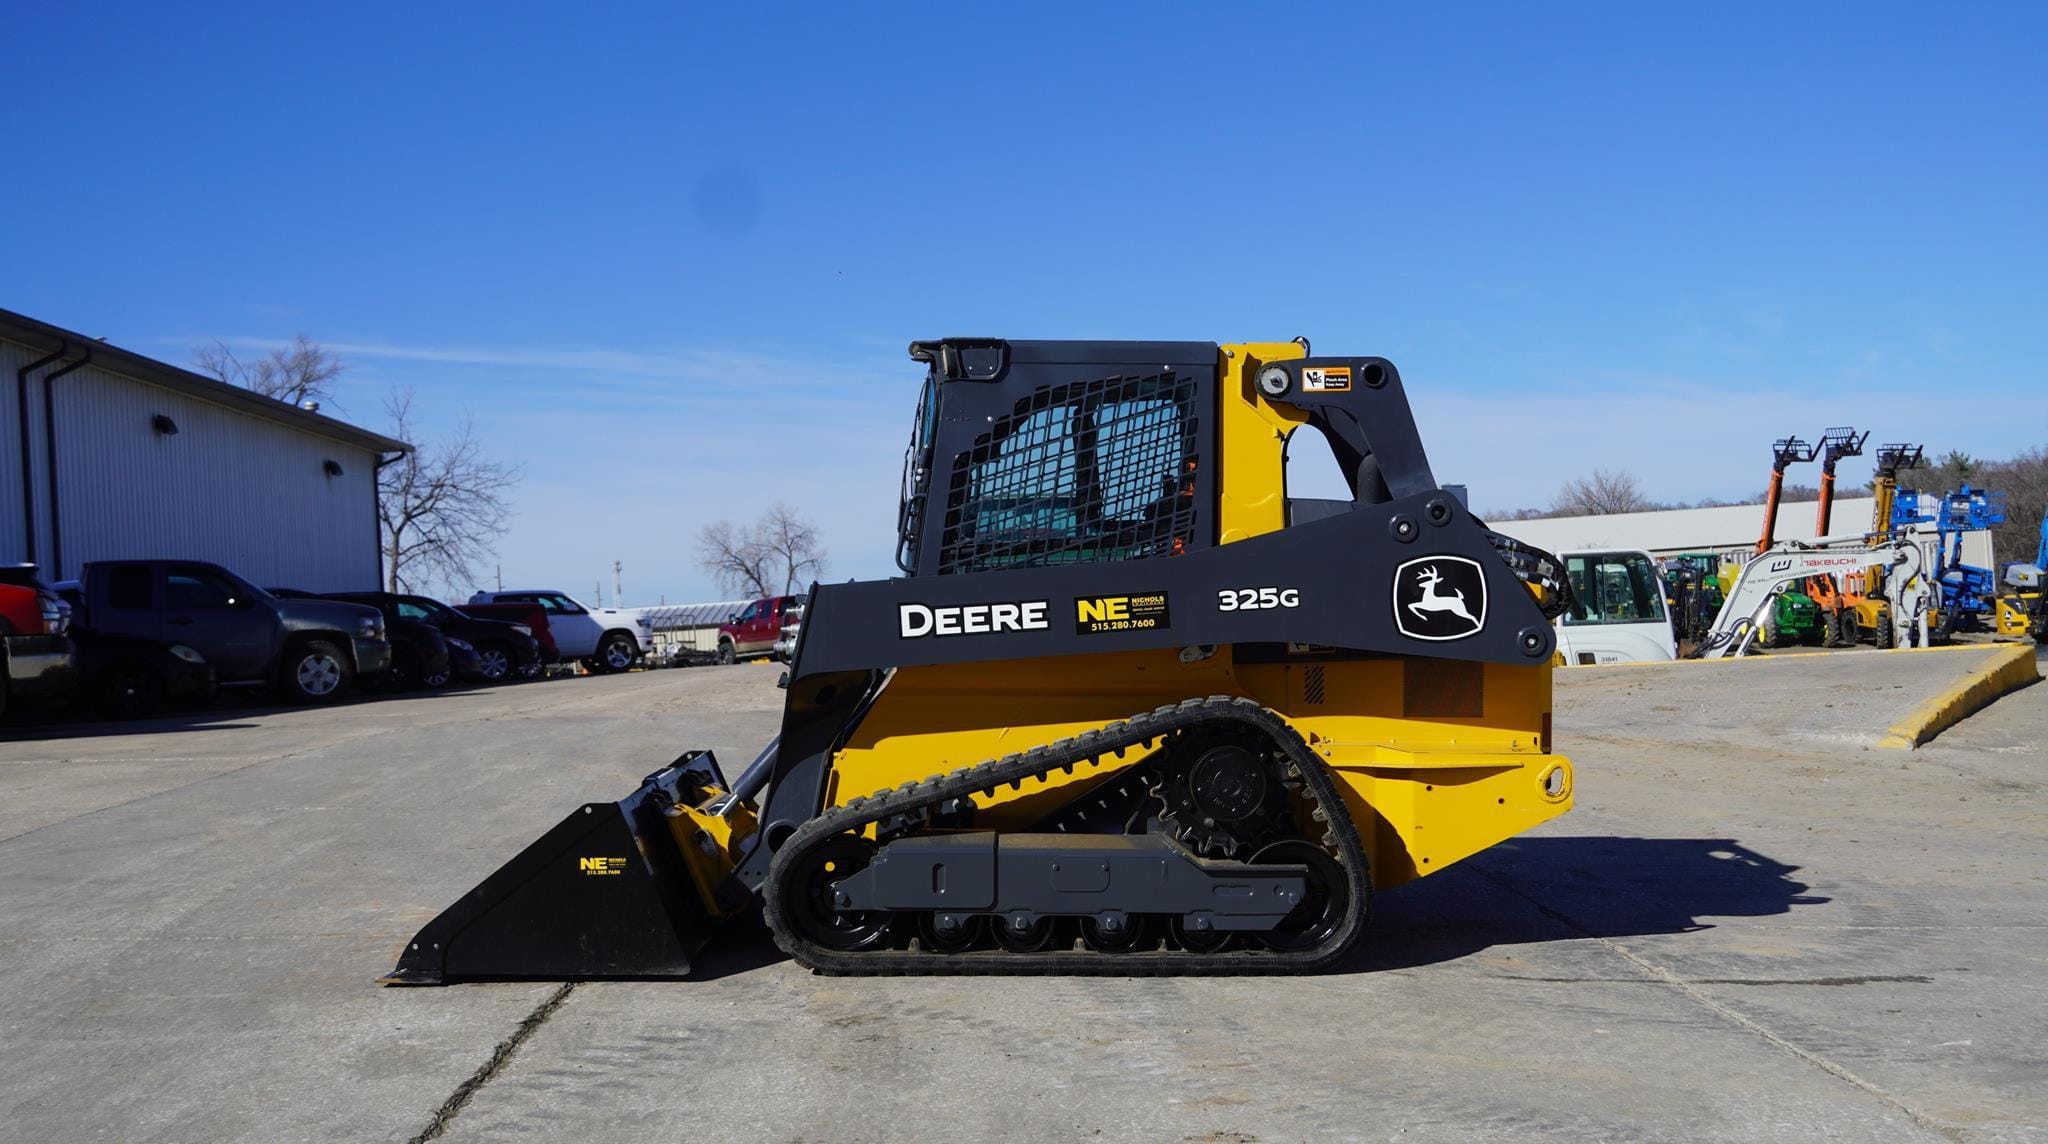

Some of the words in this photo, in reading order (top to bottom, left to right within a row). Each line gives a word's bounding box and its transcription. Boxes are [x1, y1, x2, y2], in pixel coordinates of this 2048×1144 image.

[1077, 597, 1130, 622] NE
[1218, 587, 1300, 612] 325G
[900, 601, 1049, 638] DEERE
[1091, 619, 1155, 631] 515.280.7600
[580, 857, 608, 870] NE
